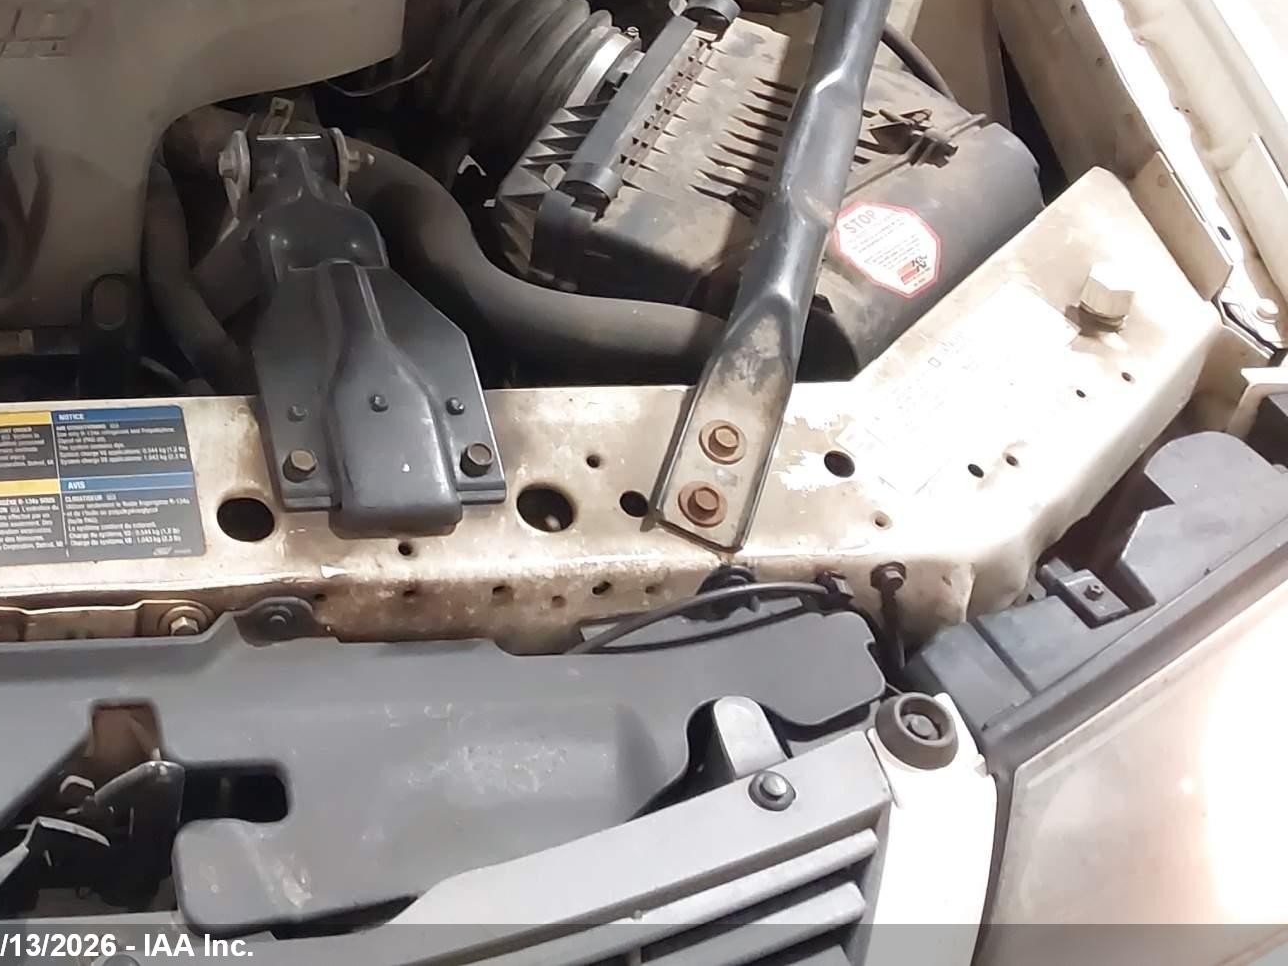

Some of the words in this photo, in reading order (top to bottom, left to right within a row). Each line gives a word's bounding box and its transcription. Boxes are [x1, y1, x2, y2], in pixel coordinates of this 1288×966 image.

[843, 209, 878, 234] STOP
[58, 413, 85, 421] NOTICE
[68, 480, 86, 490] AVIS
